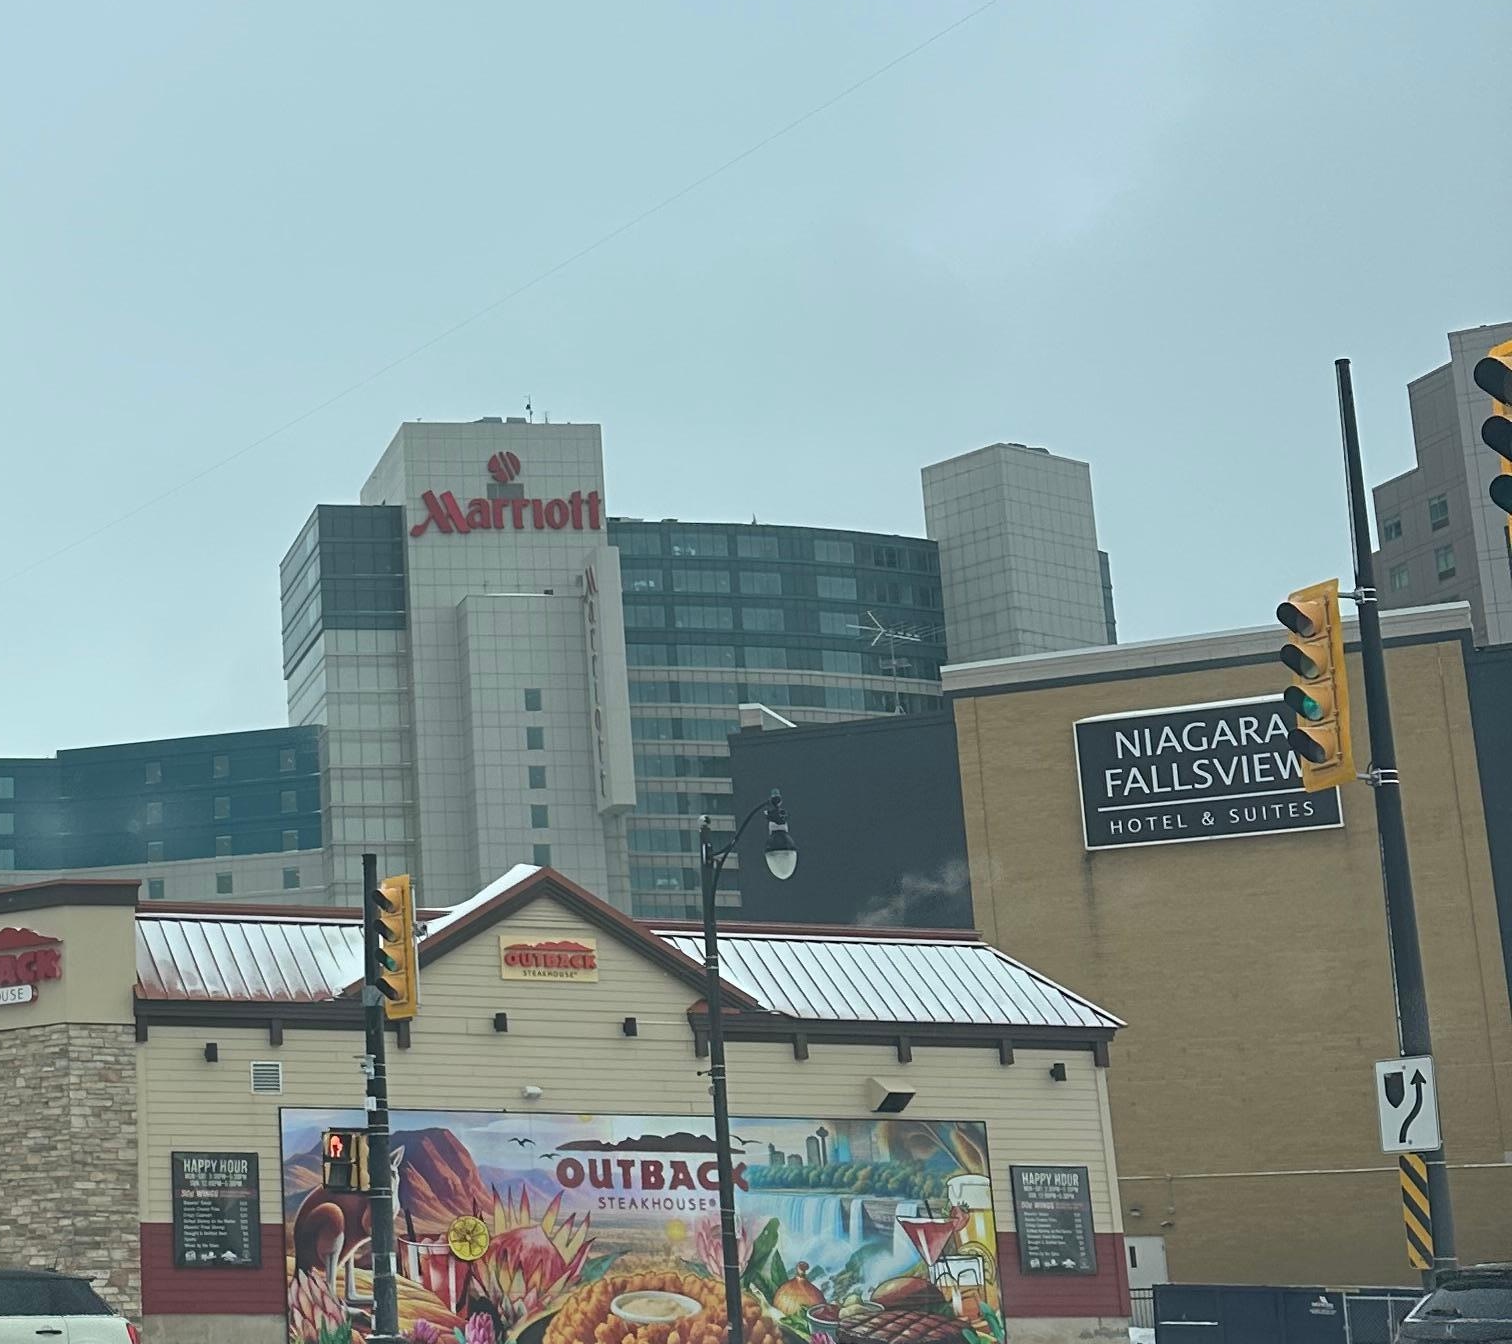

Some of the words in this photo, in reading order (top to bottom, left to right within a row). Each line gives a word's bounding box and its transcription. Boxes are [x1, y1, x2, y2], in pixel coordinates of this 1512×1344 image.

[410, 490, 602, 537] Marriott
[1115, 713, 1289, 759] NIAGARA
[1110, 814, 1188, 835] HOTEL
[1202, 811, 1215, 826] &
[1230, 801, 1315, 824] SUITES
[504, 952, 597, 969] OUTBACK
[183, 1159, 218, 1172] HAPPY
[220, 1159, 248, 1173] HOUR
[556, 1157, 749, 1192] OUTBACK
[1021, 1172, 1052, 1186] HAPPY
[1054, 1173, 1079, 1187] HOUR
